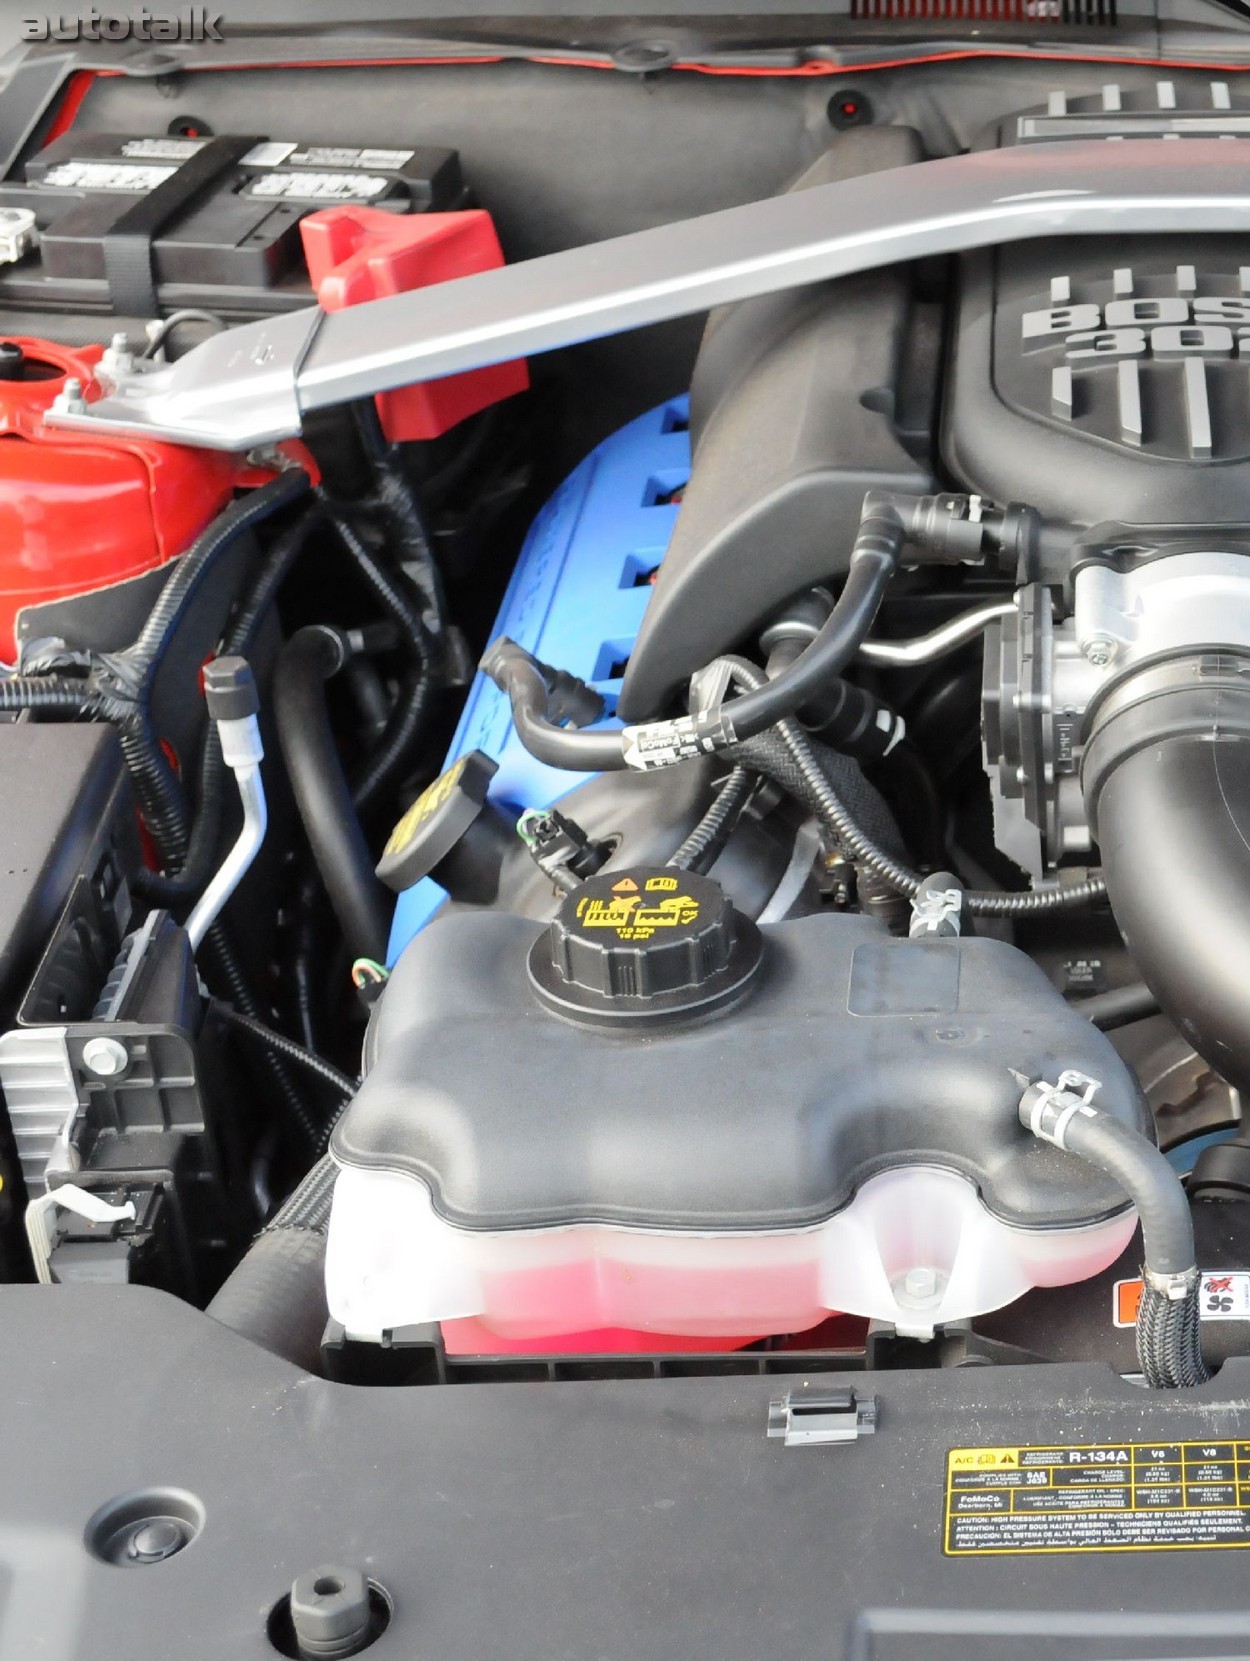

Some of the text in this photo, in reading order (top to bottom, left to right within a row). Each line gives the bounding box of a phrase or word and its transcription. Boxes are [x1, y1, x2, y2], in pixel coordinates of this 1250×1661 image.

[1069, 1451, 1128, 1463] R-134A
[1202, 1449, 1217, 1457] V8
[960, 1495, 1000, 1503] FoMoCo
